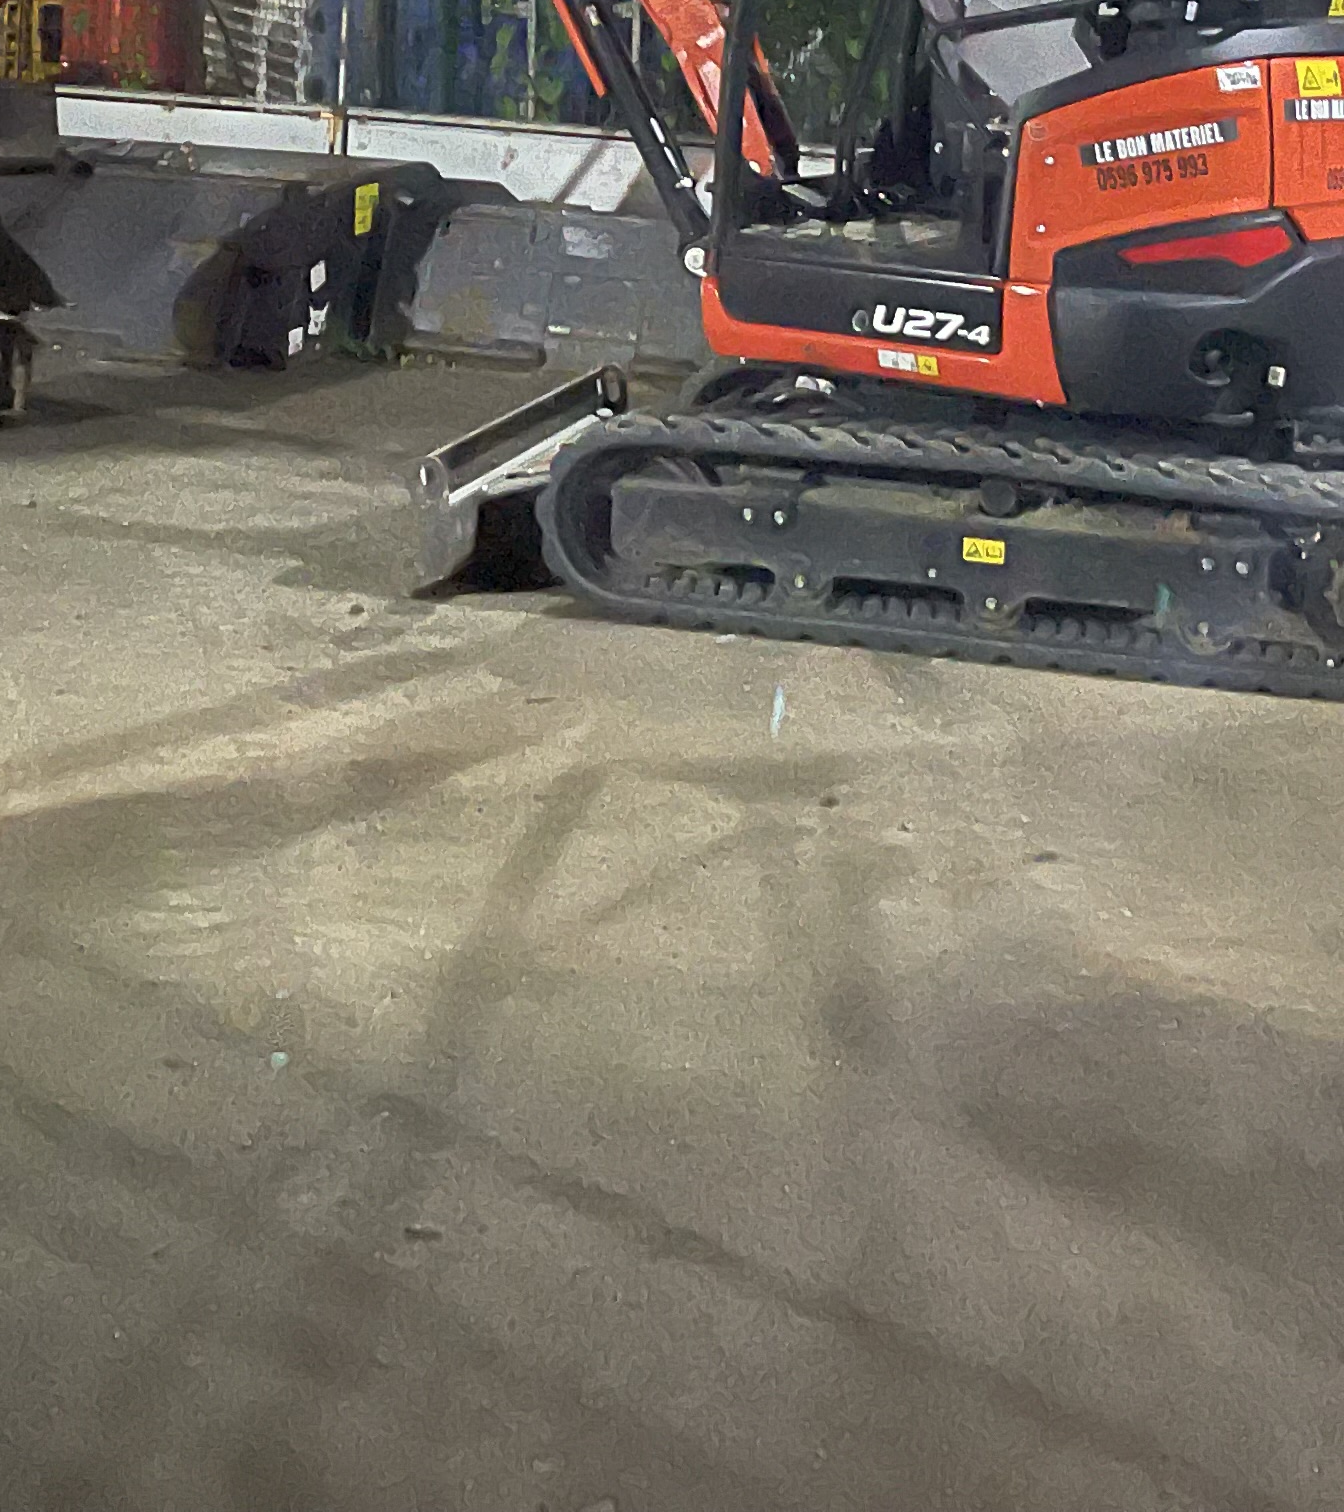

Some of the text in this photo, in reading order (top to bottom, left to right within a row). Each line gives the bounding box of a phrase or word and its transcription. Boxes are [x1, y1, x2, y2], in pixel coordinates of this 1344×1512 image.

[1294, 99, 1308, 120] LE
[1094, 122, 1224, 163] LE BON MATERIEL
[1096, 153, 1209, 191] 0596 975 993
[873, 304, 990, 346] U27-4
